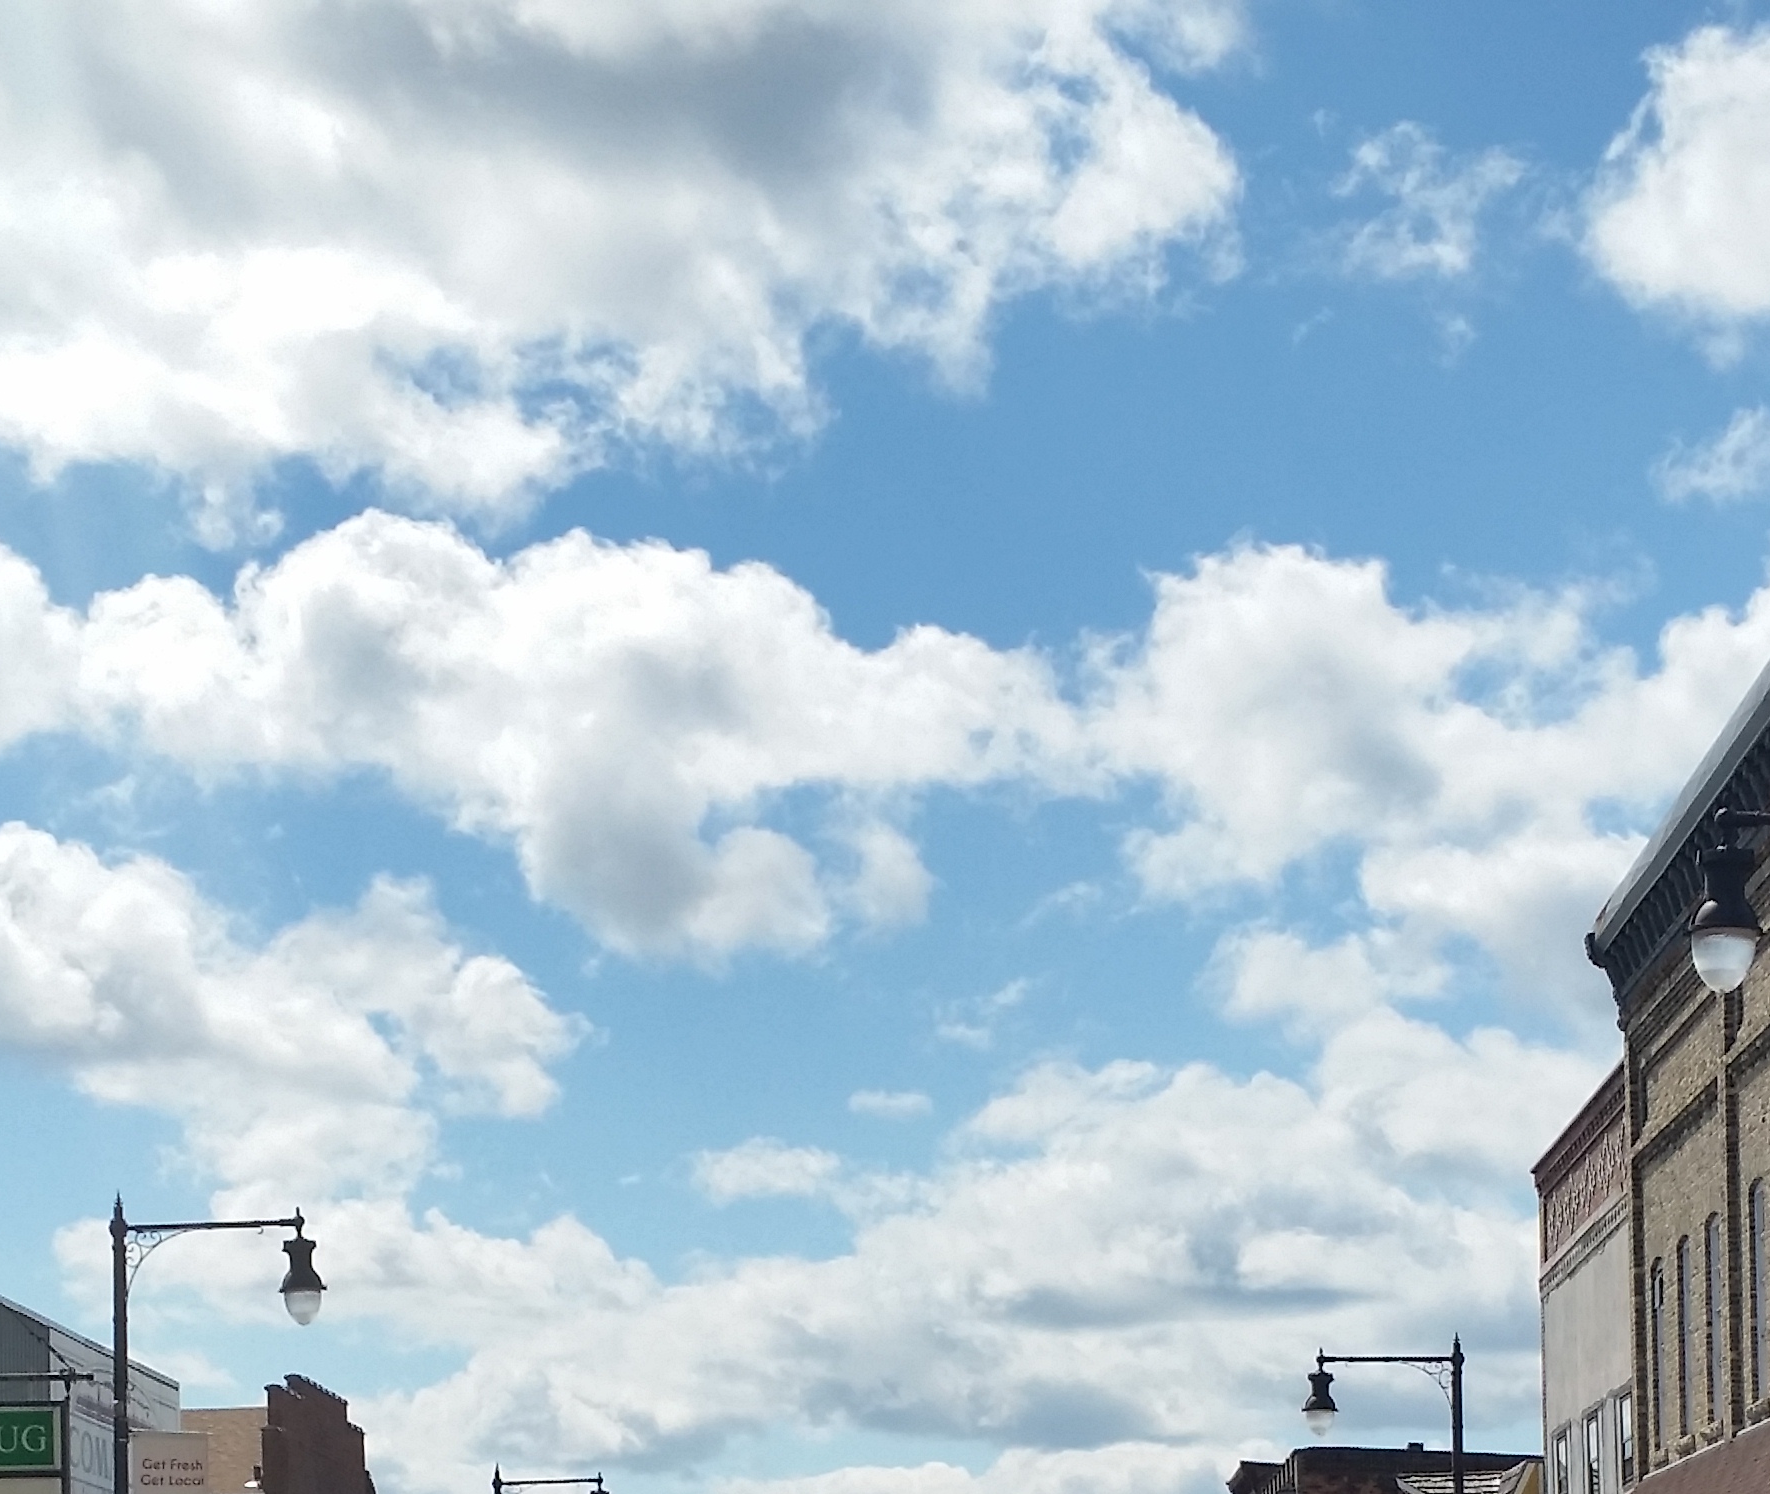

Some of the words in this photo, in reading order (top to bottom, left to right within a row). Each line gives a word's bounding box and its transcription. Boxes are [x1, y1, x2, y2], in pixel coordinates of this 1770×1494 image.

[142, 1458, 166, 1470] Get
[170, 1458, 204, 1471] Fresh
[141, 1474, 164, 1486] Get
[169, 1474, 205, 1486] Local
